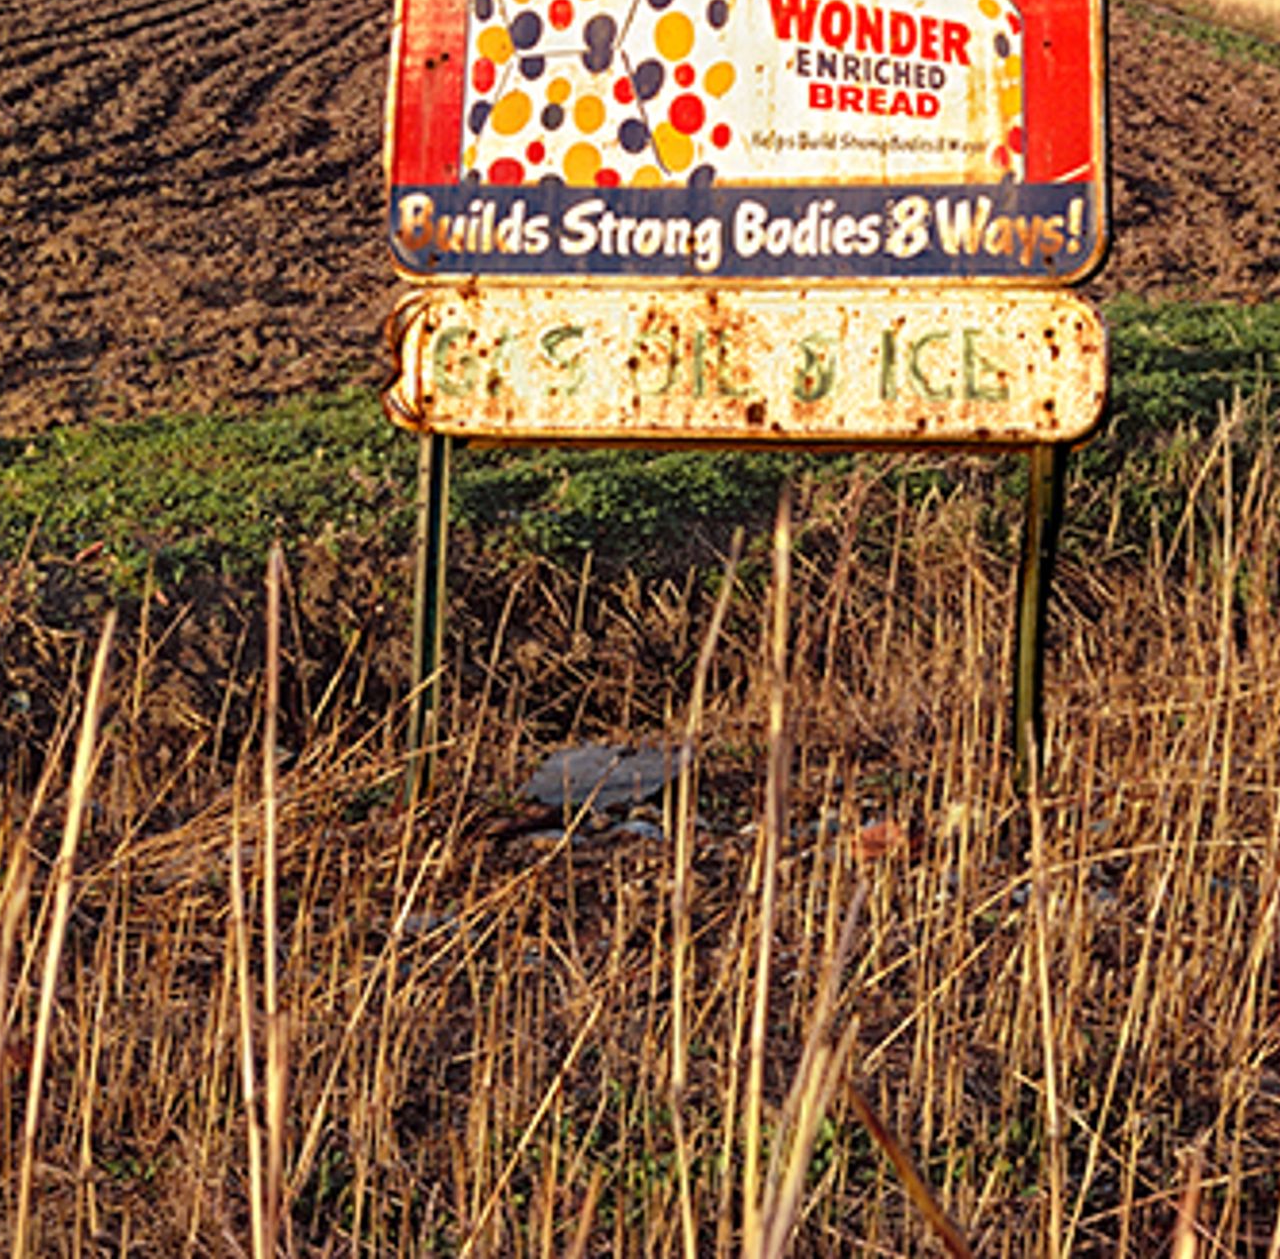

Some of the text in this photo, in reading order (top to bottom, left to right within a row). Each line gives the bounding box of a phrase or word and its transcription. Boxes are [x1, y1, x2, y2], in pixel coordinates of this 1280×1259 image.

[796, 47, 946, 90] ENRICHED
[808, 83, 940, 119] BREAD
[398, 192, 1084, 273] Builds Strong Bodies 8 Ways!
[880, 327, 1010, 402] ICE
